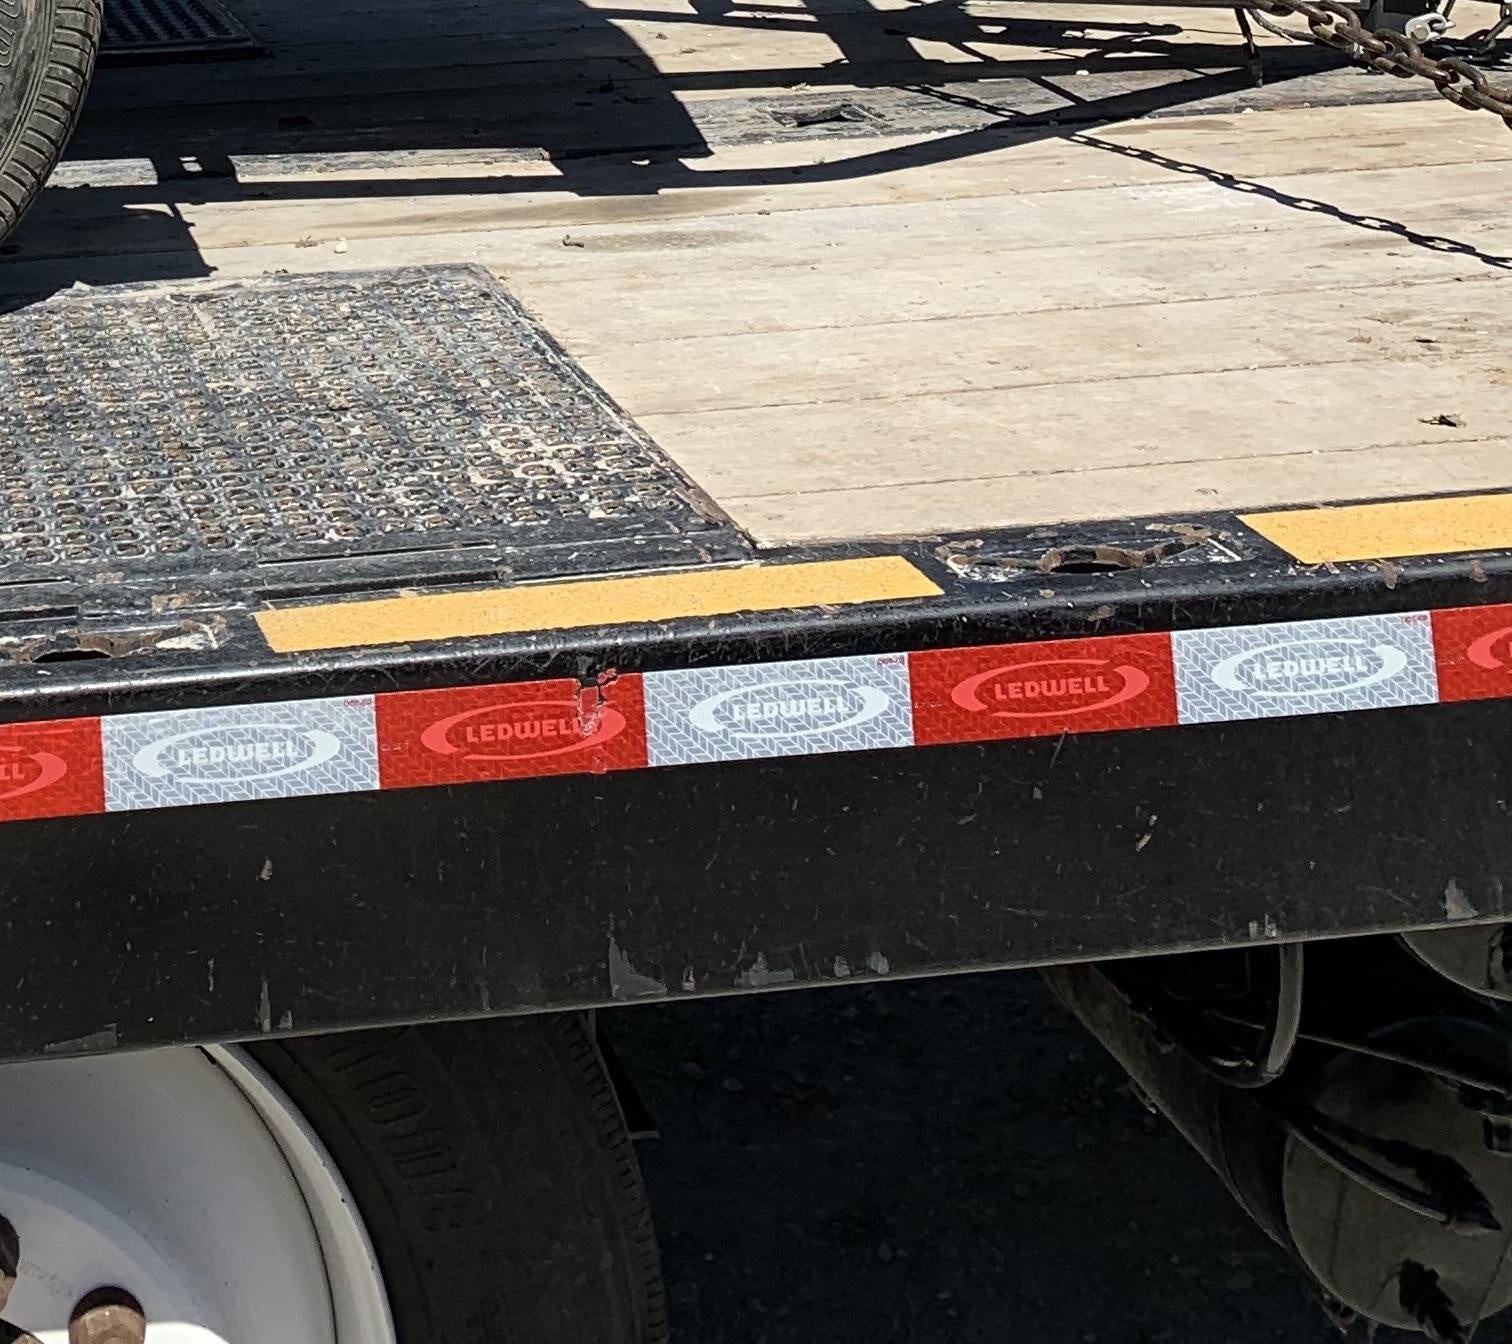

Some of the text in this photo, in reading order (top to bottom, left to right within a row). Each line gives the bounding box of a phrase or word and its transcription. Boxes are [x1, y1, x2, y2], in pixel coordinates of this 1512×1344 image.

[1253, 653, 1369, 682] LEDWELL
[994, 673, 1112, 702] LEDWELL
[732, 694, 849, 724] LEDWELL
[178, 738, 298, 769] LEDWELL
